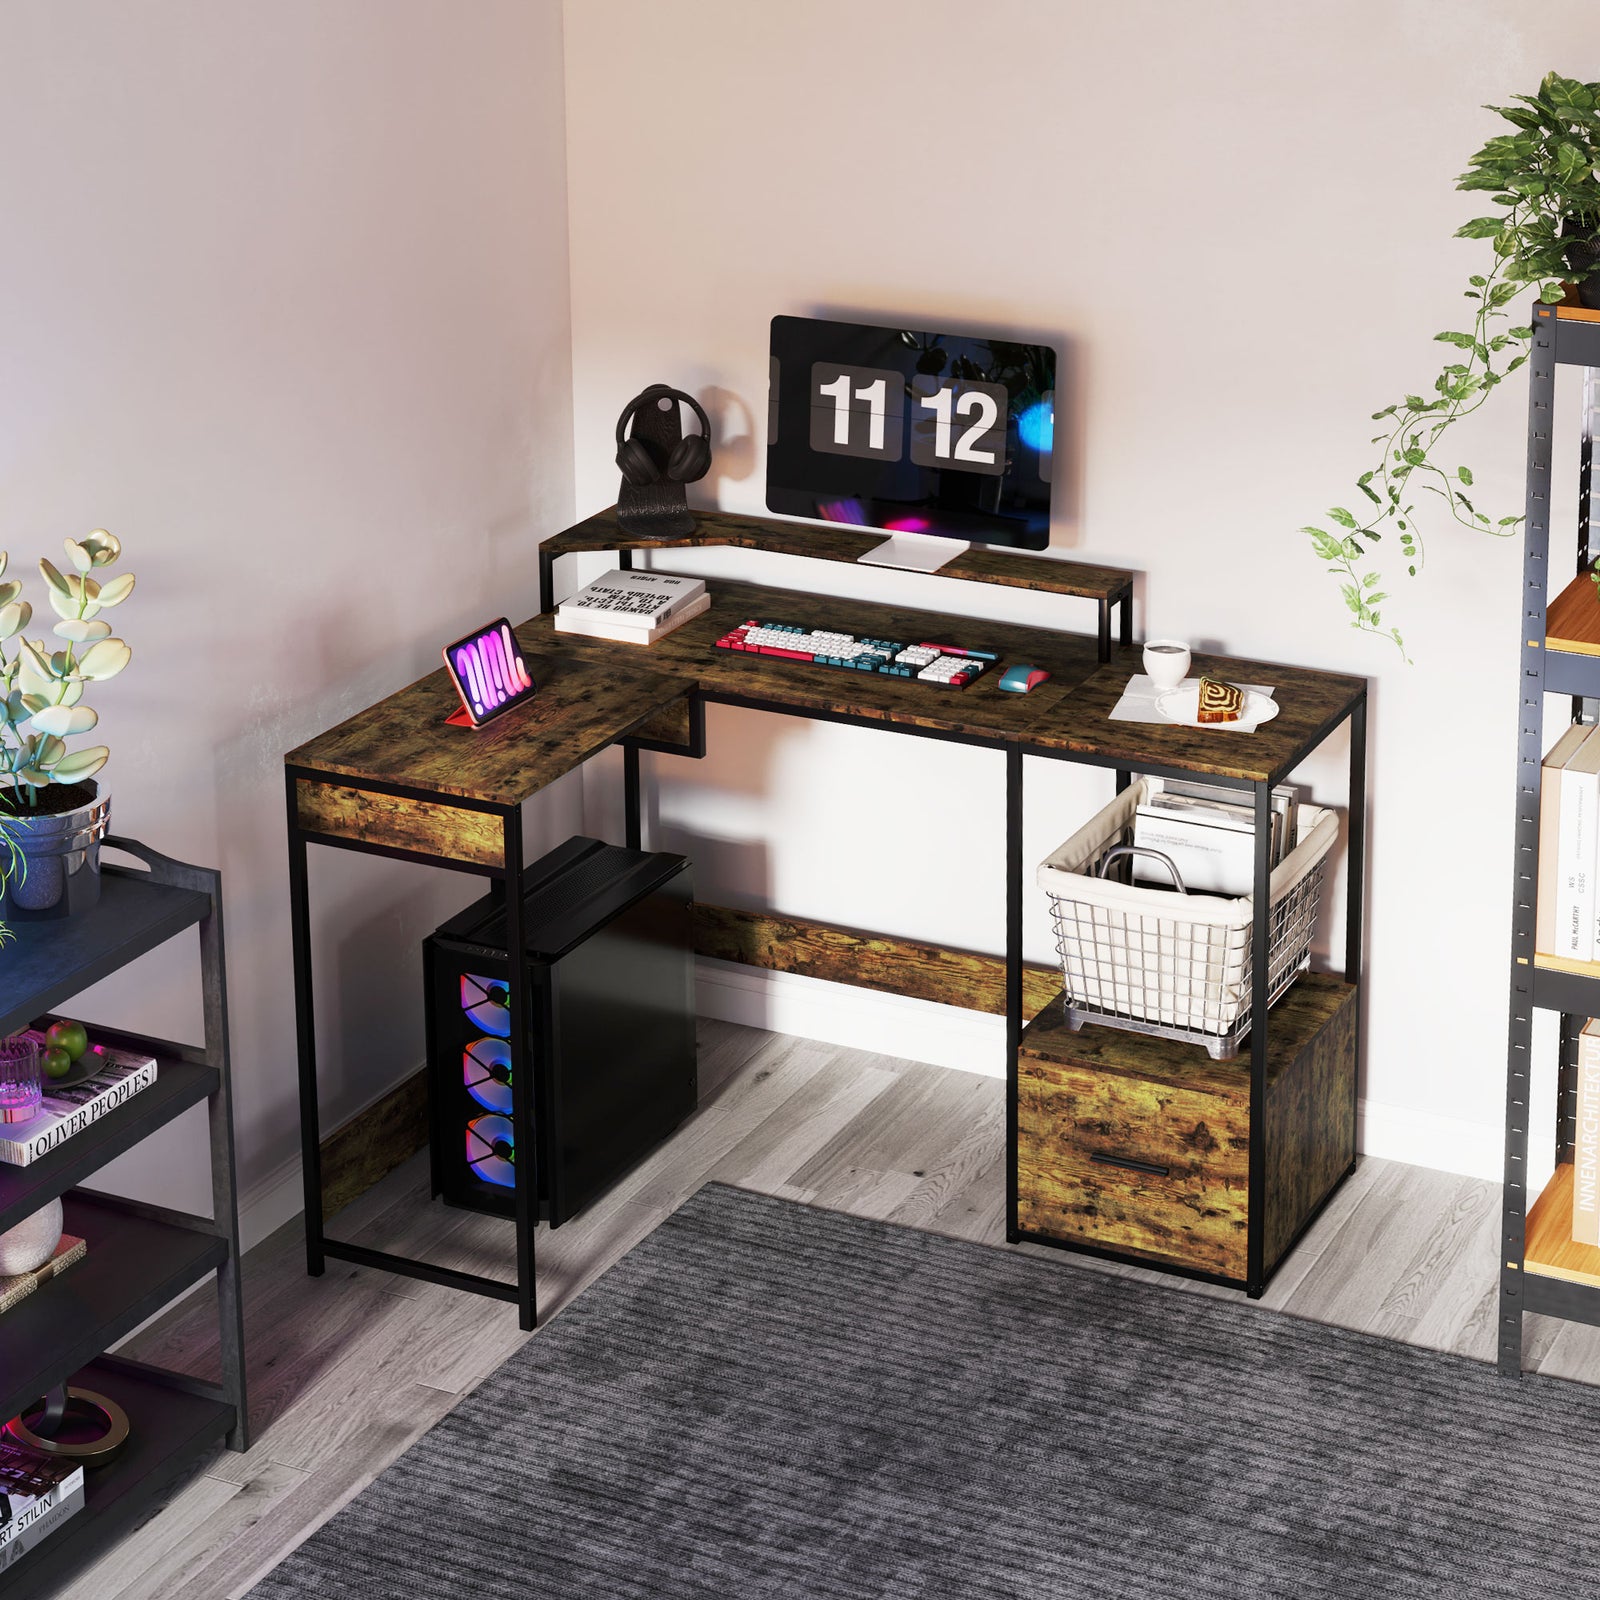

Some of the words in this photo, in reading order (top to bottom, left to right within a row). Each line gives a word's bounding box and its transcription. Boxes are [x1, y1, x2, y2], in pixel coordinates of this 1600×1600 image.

[819, 374, 887, 450] 11
[920, 387, 999, 465] 12
[590, 586, 624, 595] СТАТЬ
[627, 591, 673, 601] ХОЧЕШЬ
[613, 605, 654, 615] ВАЖНО
[1571, 936, 1579, 951] PAUL
[36, 1110, 87, 1156] OLIVER
[90, 1069, 149, 1122] PEOPLES
[1580, 1037, 1600, 1213] INNENARCHITEKTUR
[17, 1494, 52, 1531] STILIN
